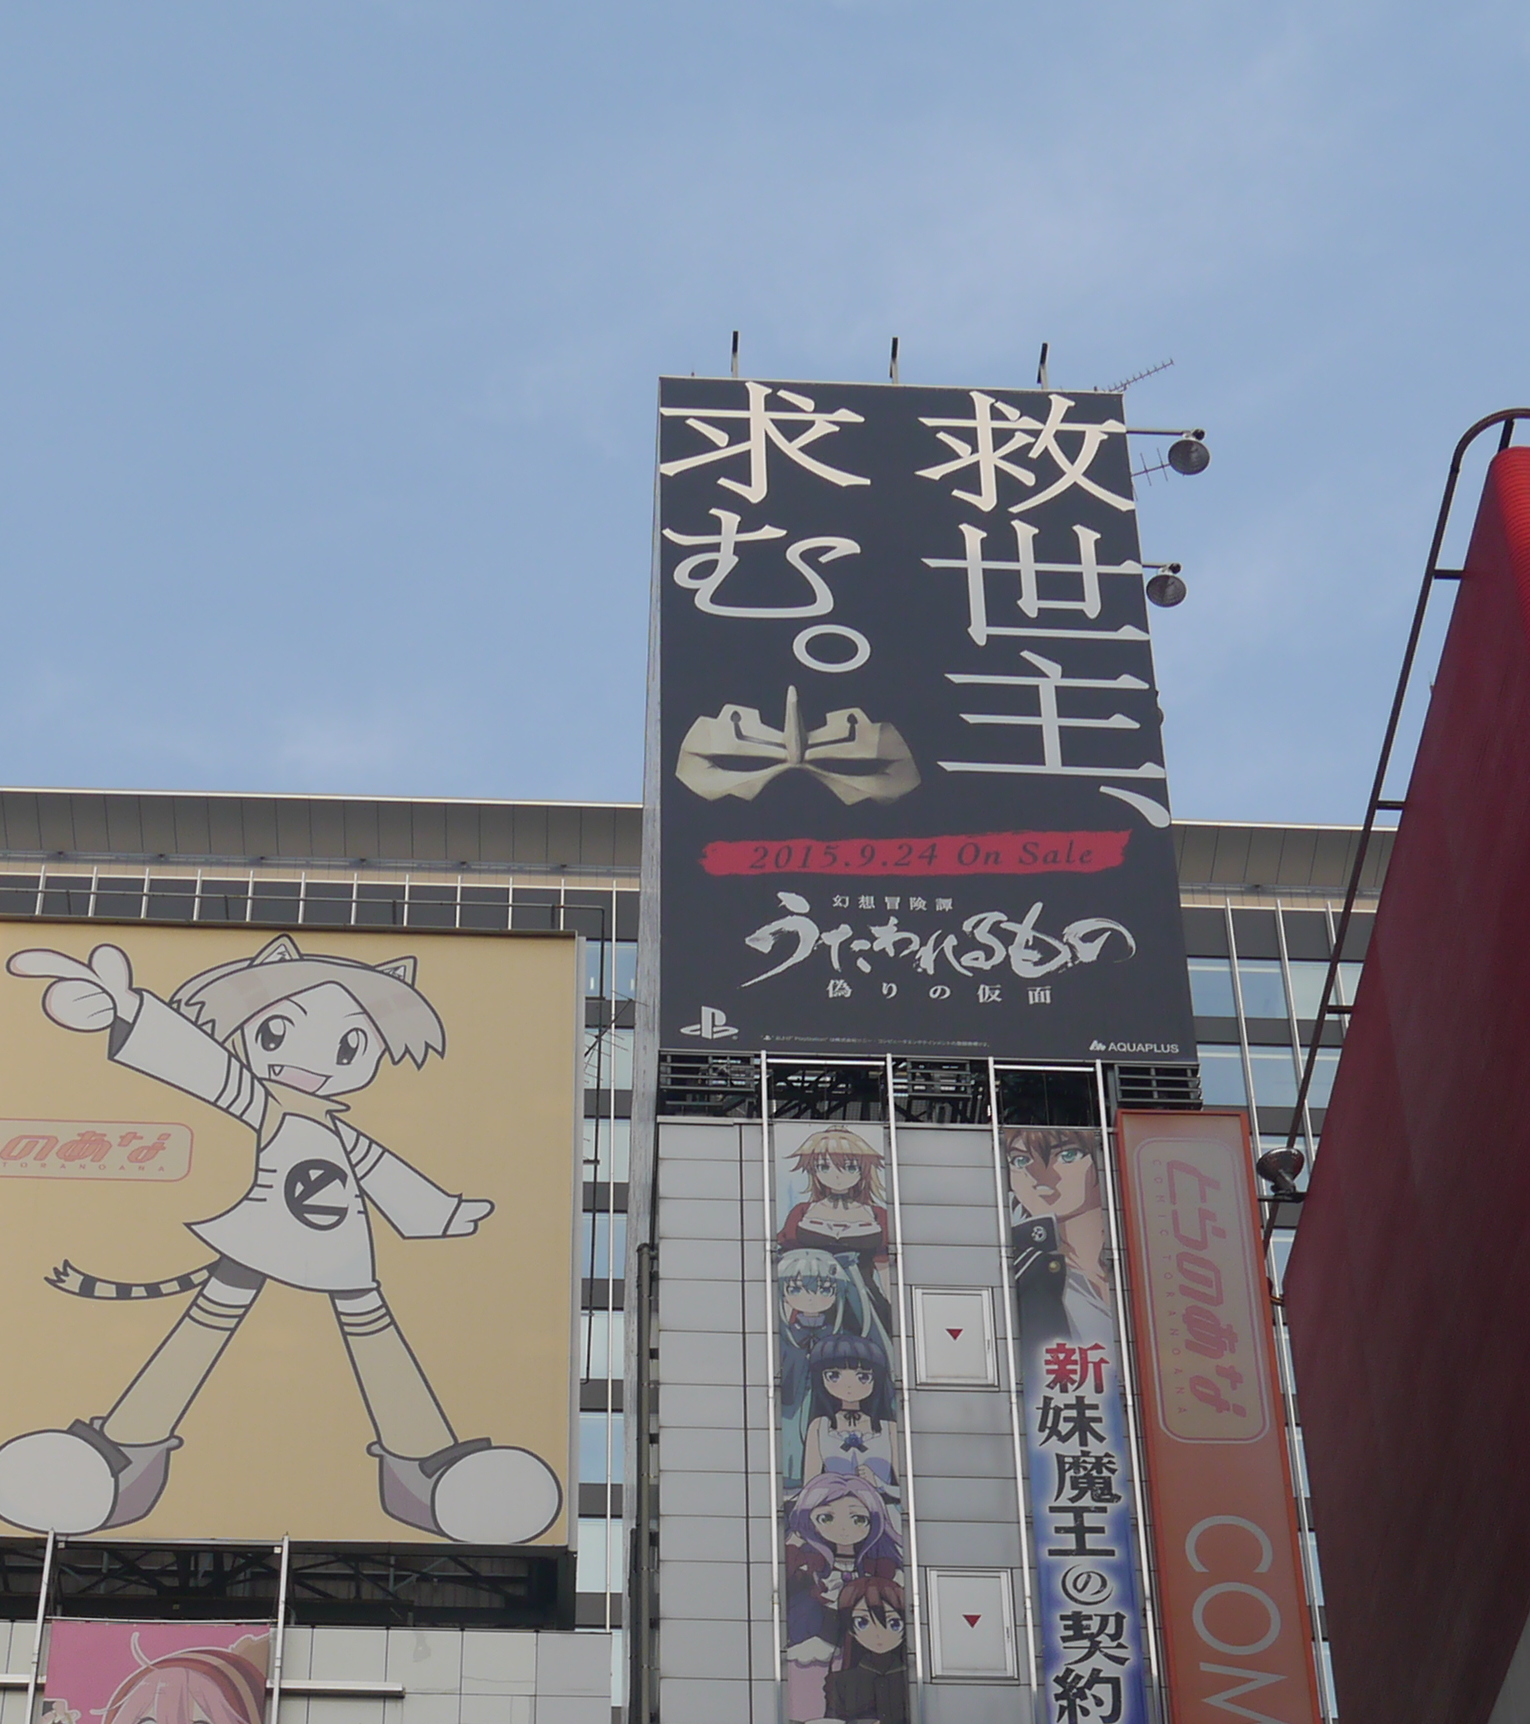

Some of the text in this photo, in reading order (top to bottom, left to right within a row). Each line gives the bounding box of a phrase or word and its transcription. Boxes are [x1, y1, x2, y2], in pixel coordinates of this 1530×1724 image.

[660, 381, 871, 673] 求む。
[750, 841, 1094, 870] 2015.9.24 On Sale
[737, 892, 1137, 988] うたわれるもの
[827, 980, 1052, 1005] 偽りの仮面
[1108, 1042, 1180, 1054] AQUAPLUS
[1, 1161, 167, 1172] TORANOANA
[1152, 1159, 1188, 1413] COMIC TORANOANA
[1167, 1159, 1247, 1419] とらのあな
